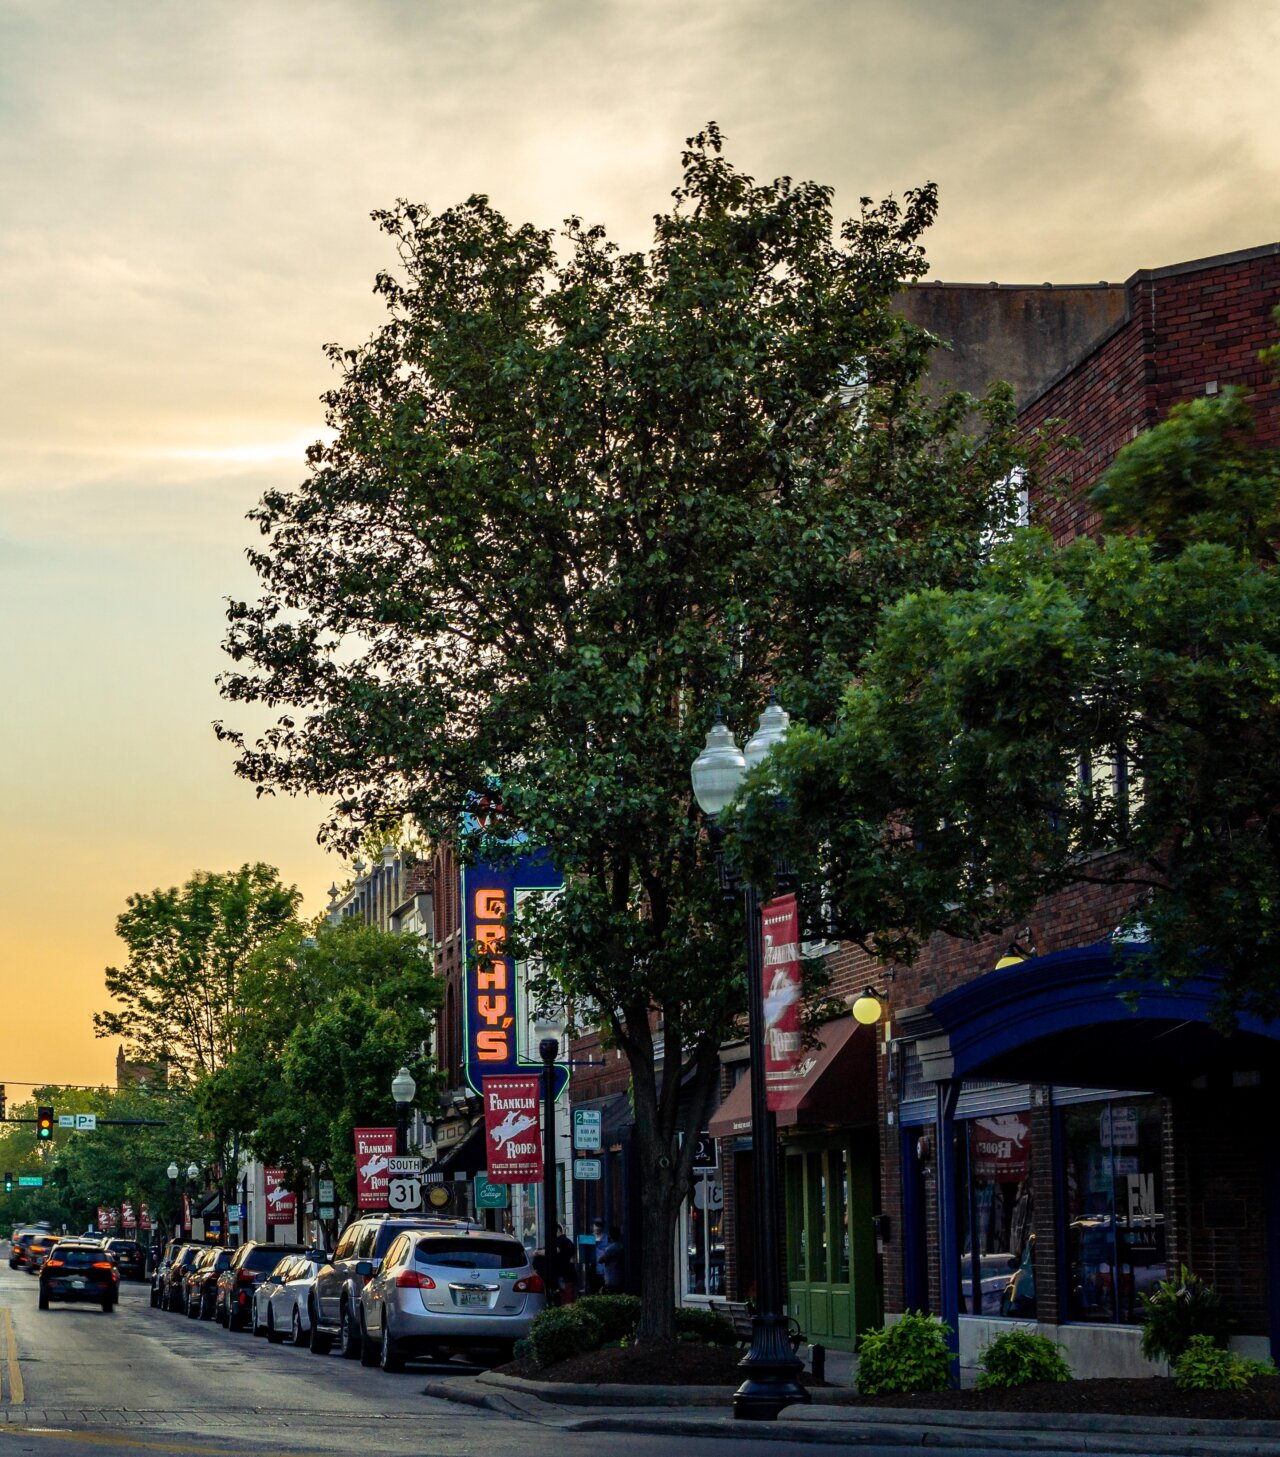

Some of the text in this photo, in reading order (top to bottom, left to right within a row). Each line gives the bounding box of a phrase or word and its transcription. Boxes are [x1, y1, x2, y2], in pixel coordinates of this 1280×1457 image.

[475, 889, 513, 1061] GRAY'S
[489, 1093, 536, 1111] FRANKLIN
[78, 1116, 87, 1127] P
[576, 1113, 583, 1124] 2
[359, 1140, 393, 1155] FRANKLIN
[506, 1141, 537, 1159] RODEO
[389, 1159, 420, 1170] SOUTH
[371, 1176, 388, 1190] ROD
[395, 1184, 414, 1203] 31
[480, 1190, 501, 1198] Cottage
